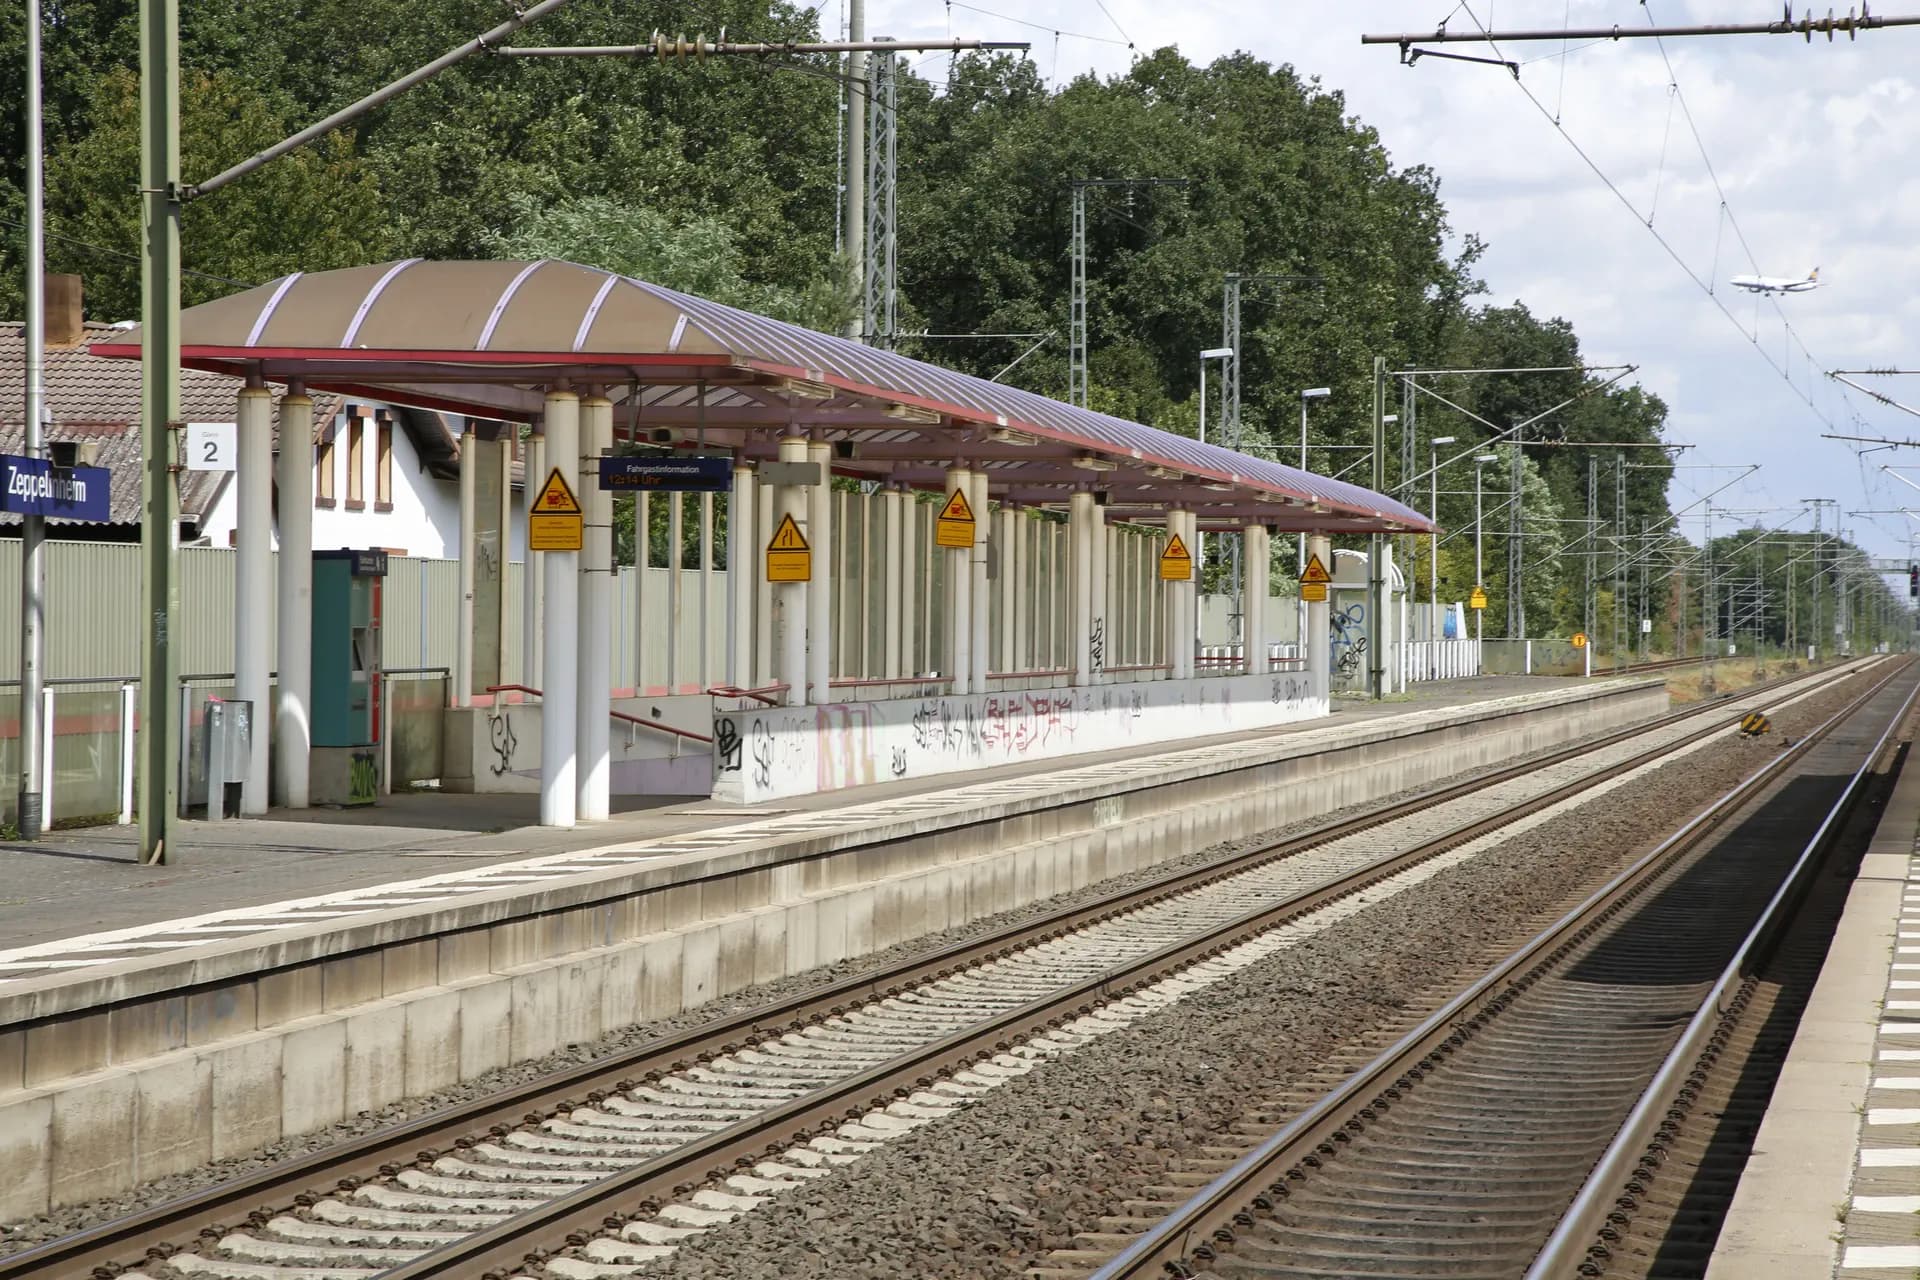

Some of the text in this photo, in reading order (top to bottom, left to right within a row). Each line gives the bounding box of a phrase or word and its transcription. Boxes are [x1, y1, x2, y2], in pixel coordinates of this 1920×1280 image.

[203, 441, 218, 462] 2
[626, 464, 700, 474] Fahrgastinformation
[8, 465, 86, 502] Zeppelinheim
